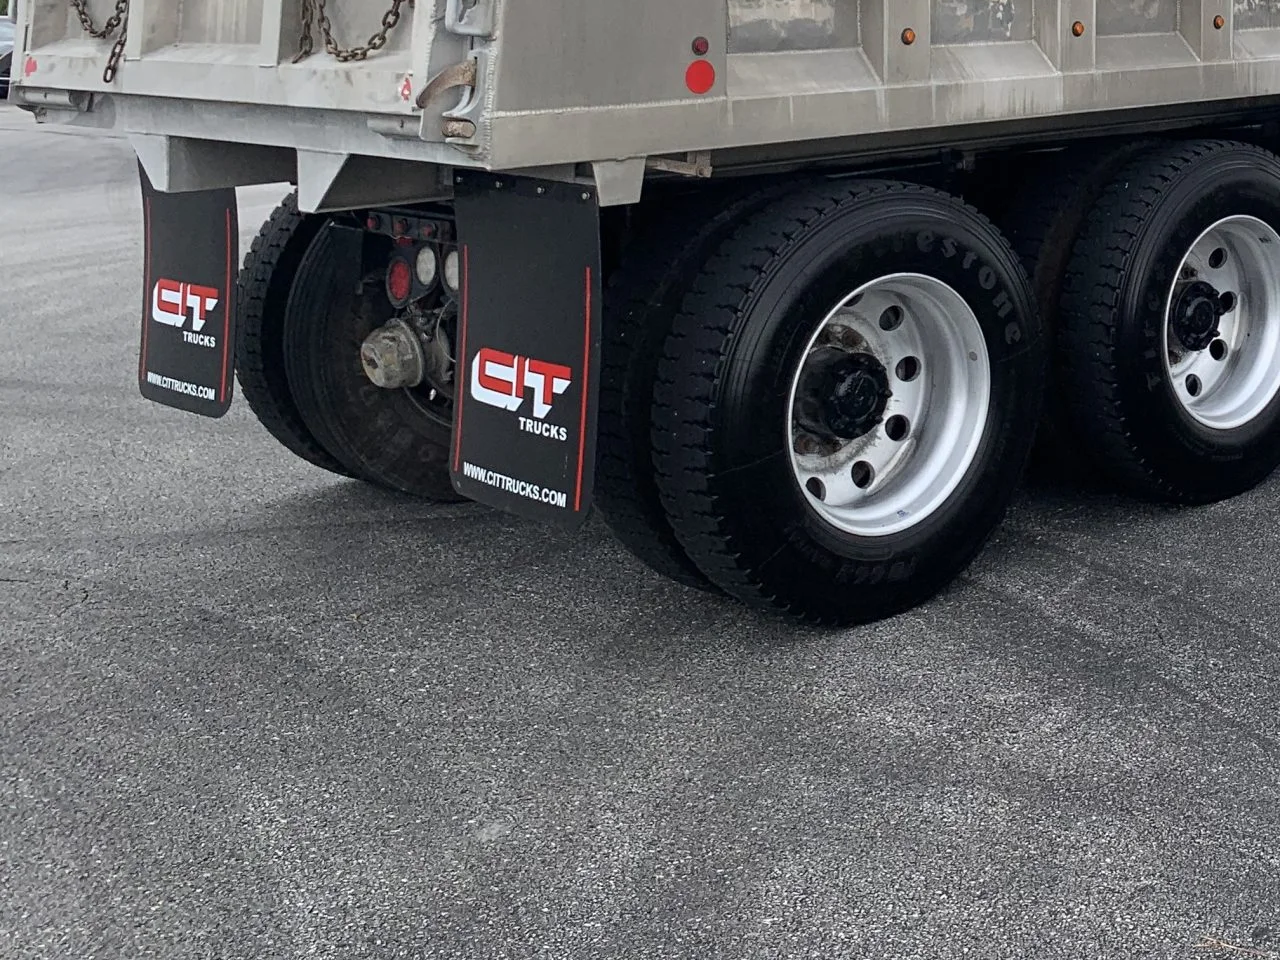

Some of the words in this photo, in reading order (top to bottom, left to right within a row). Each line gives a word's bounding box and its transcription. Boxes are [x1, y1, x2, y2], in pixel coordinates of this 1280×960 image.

[152, 278, 219, 331] CIT
[183, 331, 216, 348] TRUCKS
[147, 371, 216, 401] WWW.CITTRUCKS.COM
[471, 347, 572, 419] CIT
[518, 416, 568, 441] TRUCKS
[463, 461, 567, 508] WWW.CITTRUCKS.COM
